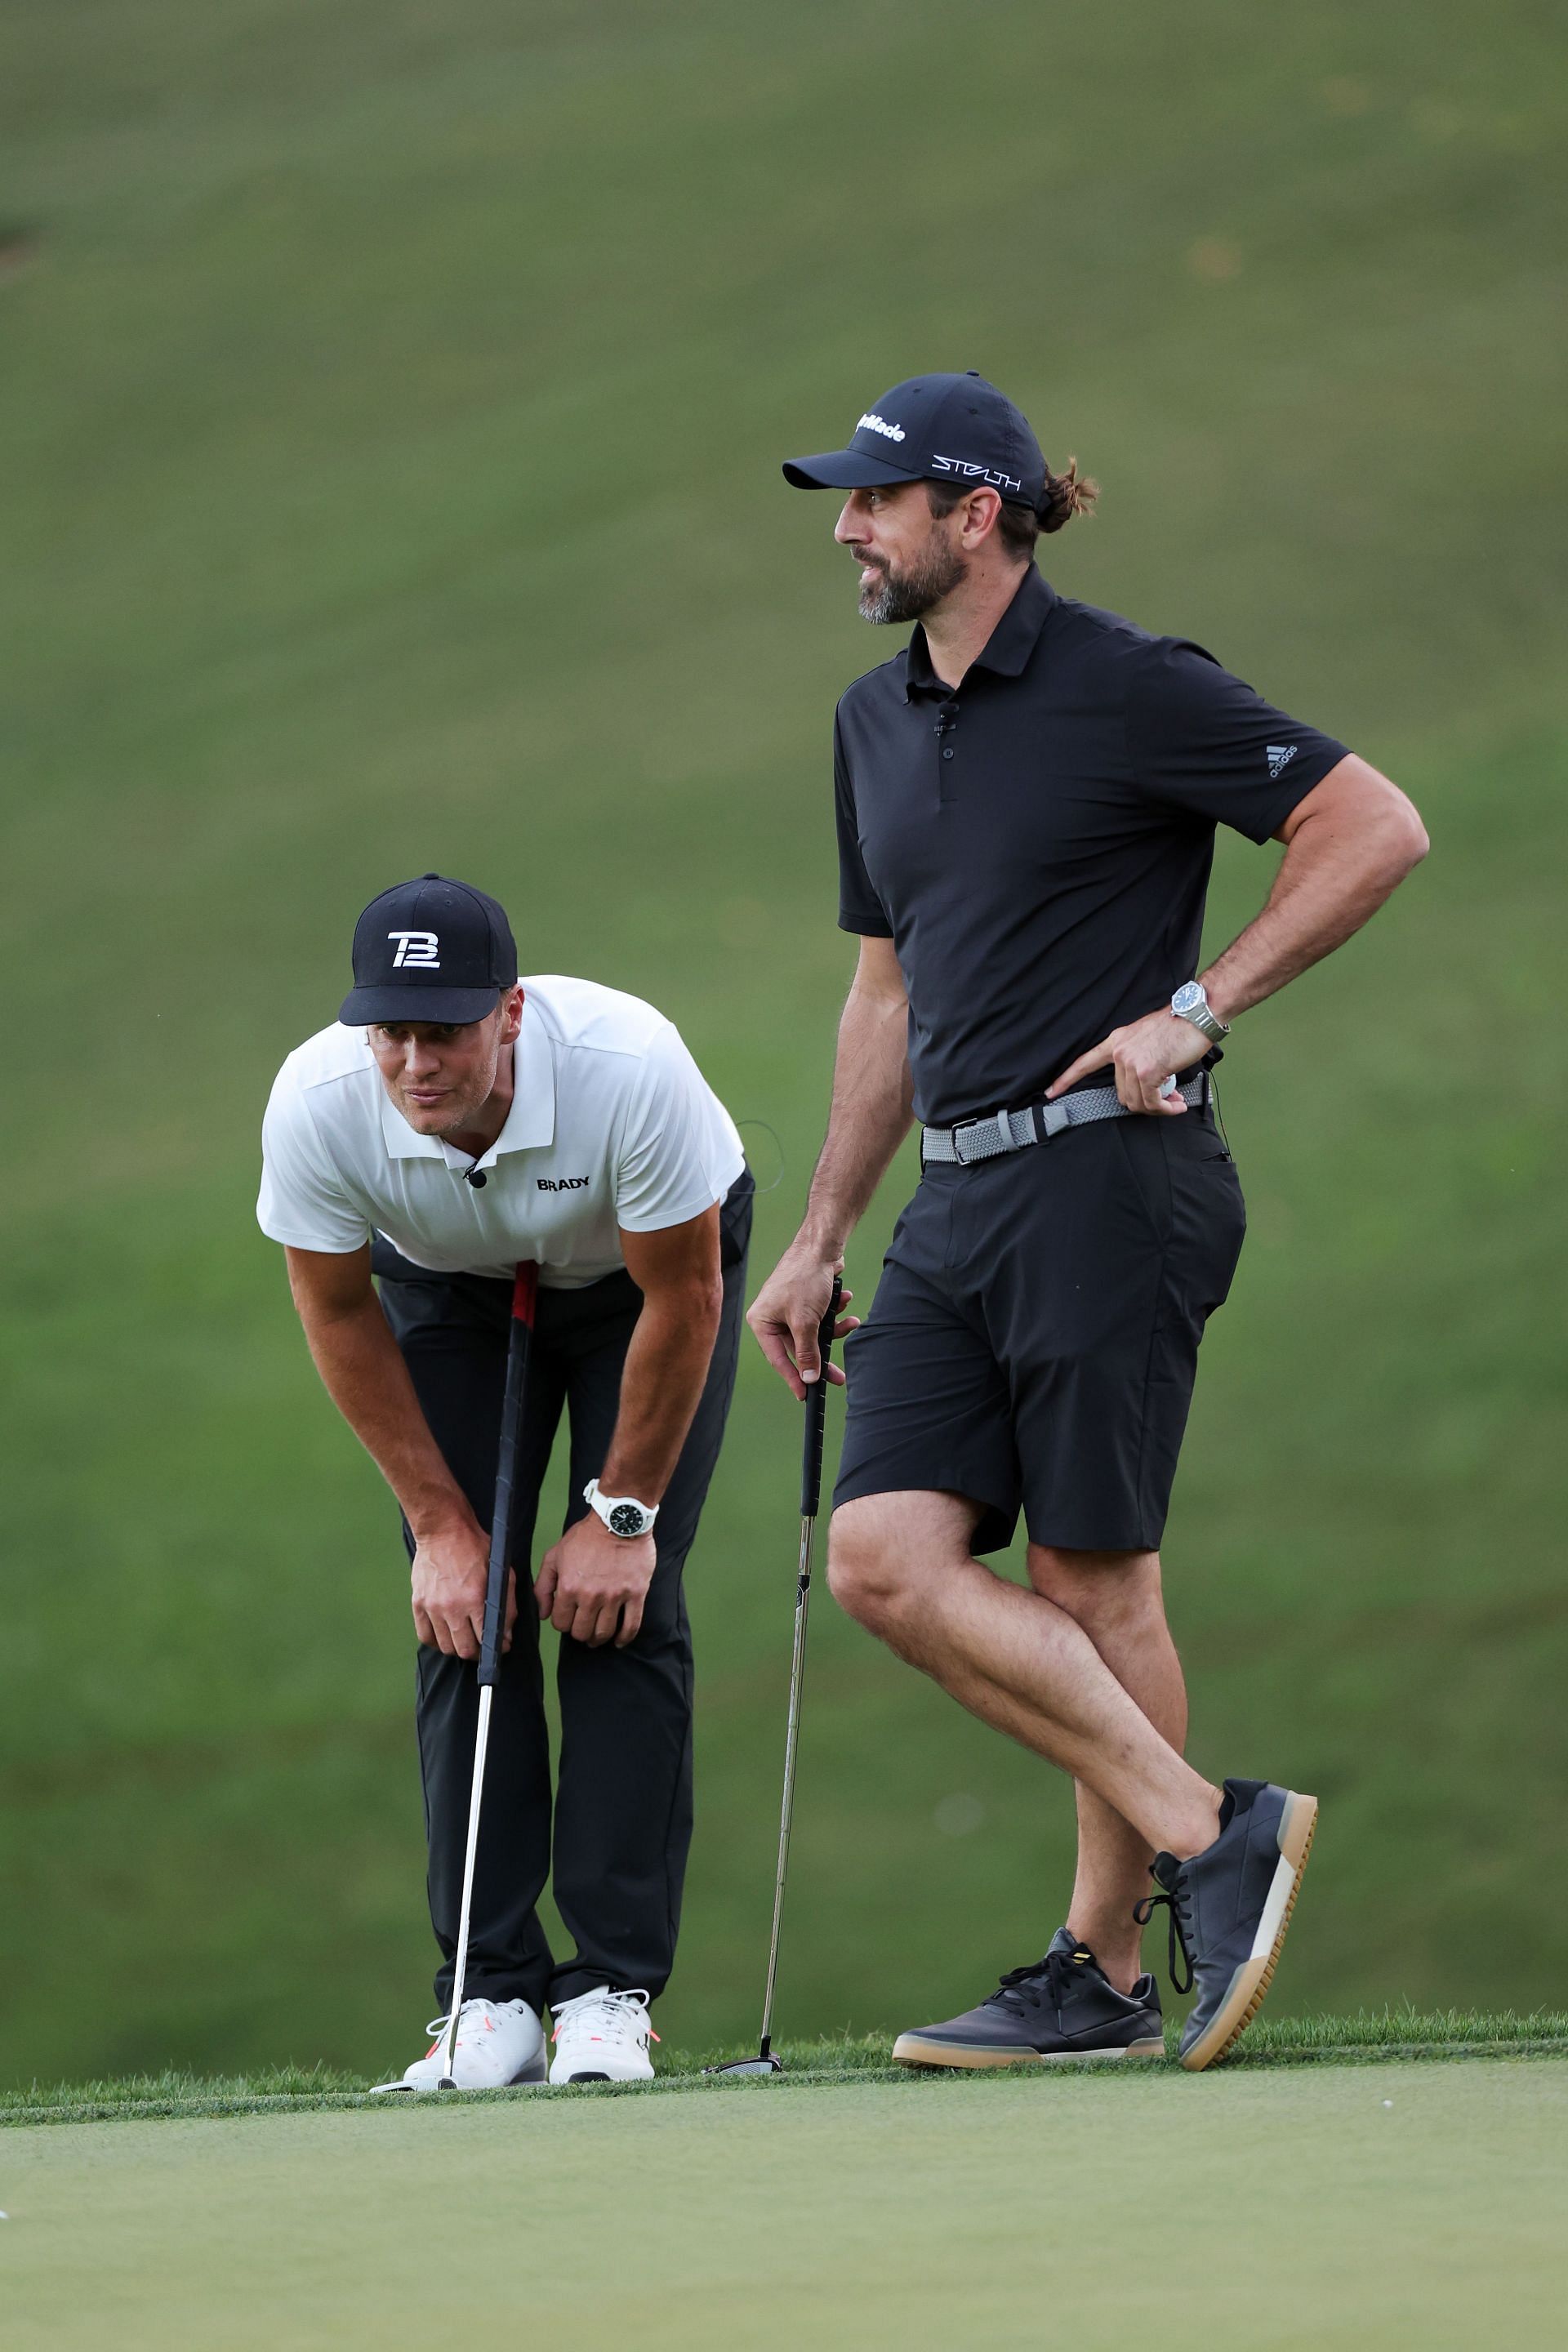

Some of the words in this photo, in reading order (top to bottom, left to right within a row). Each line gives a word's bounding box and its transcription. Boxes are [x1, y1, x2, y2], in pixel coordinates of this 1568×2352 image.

[932, 454, 1021, 492] STEALTH
[1269, 745, 1298, 778] adidas
[537, 1176, 590, 1192] BRADY
